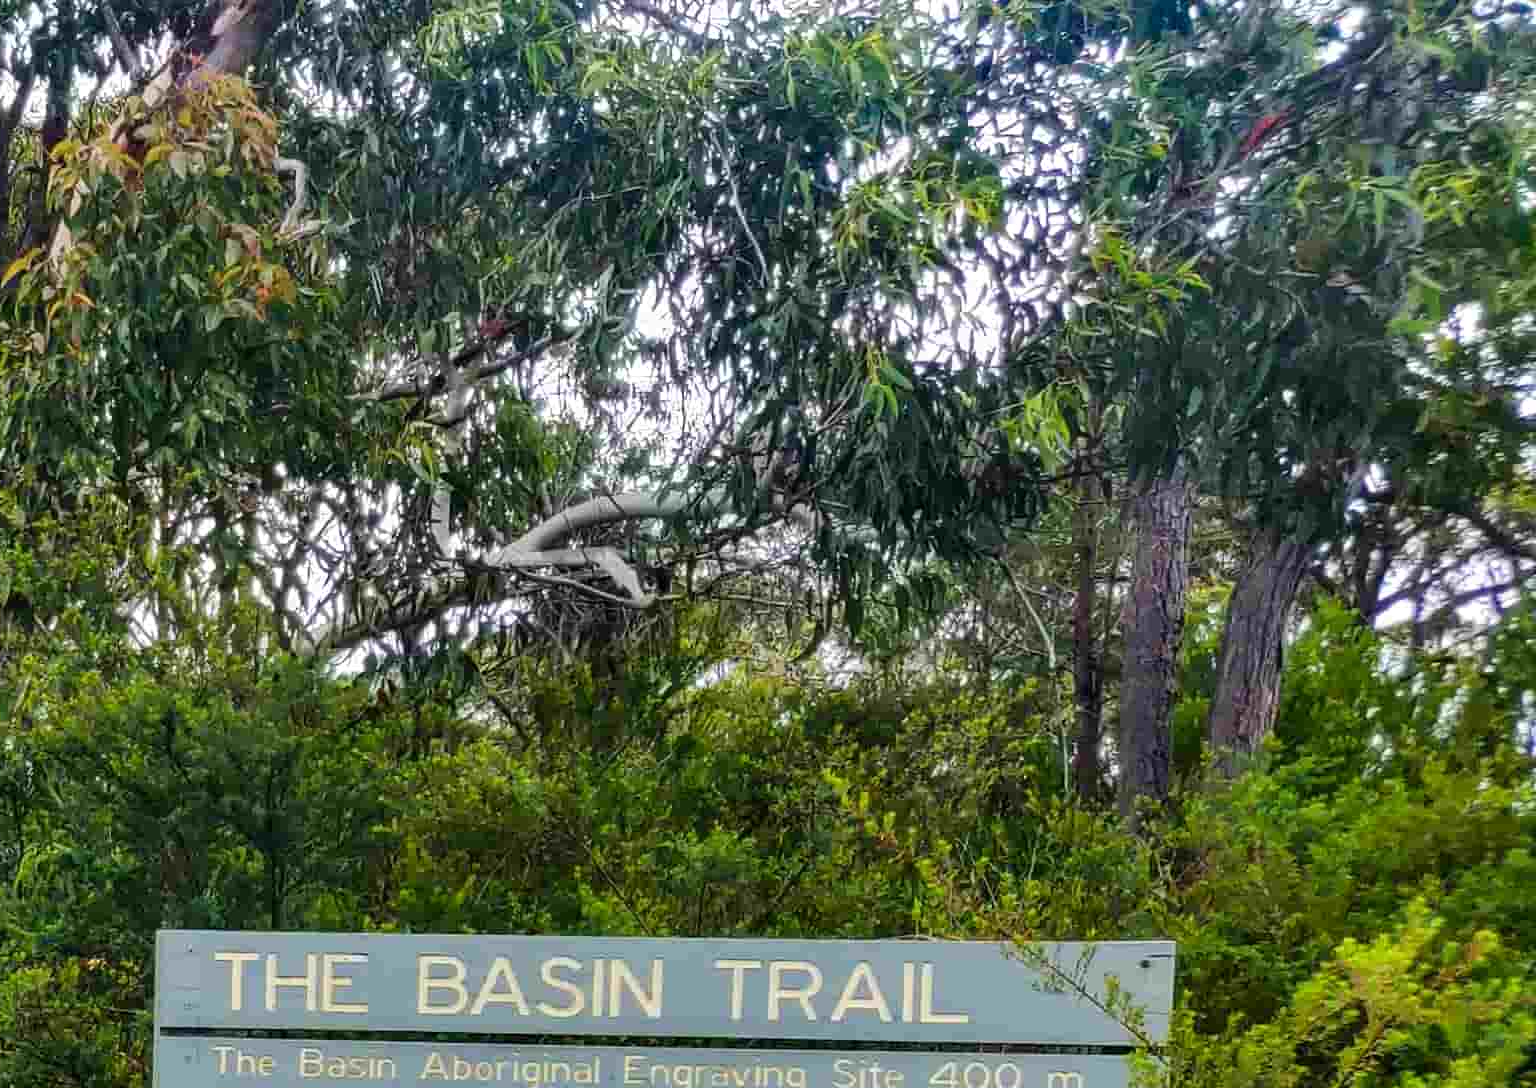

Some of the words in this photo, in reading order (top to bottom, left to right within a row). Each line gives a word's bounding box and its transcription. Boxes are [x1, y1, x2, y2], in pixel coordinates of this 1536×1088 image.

[213, 951, 368, 1014] THE
[415, 952, 666, 1019] BASIN
[715, 958, 970, 1024] TRAIL
[210, 1046, 275, 1079] The
[297, 1047, 398, 1081] Basin
